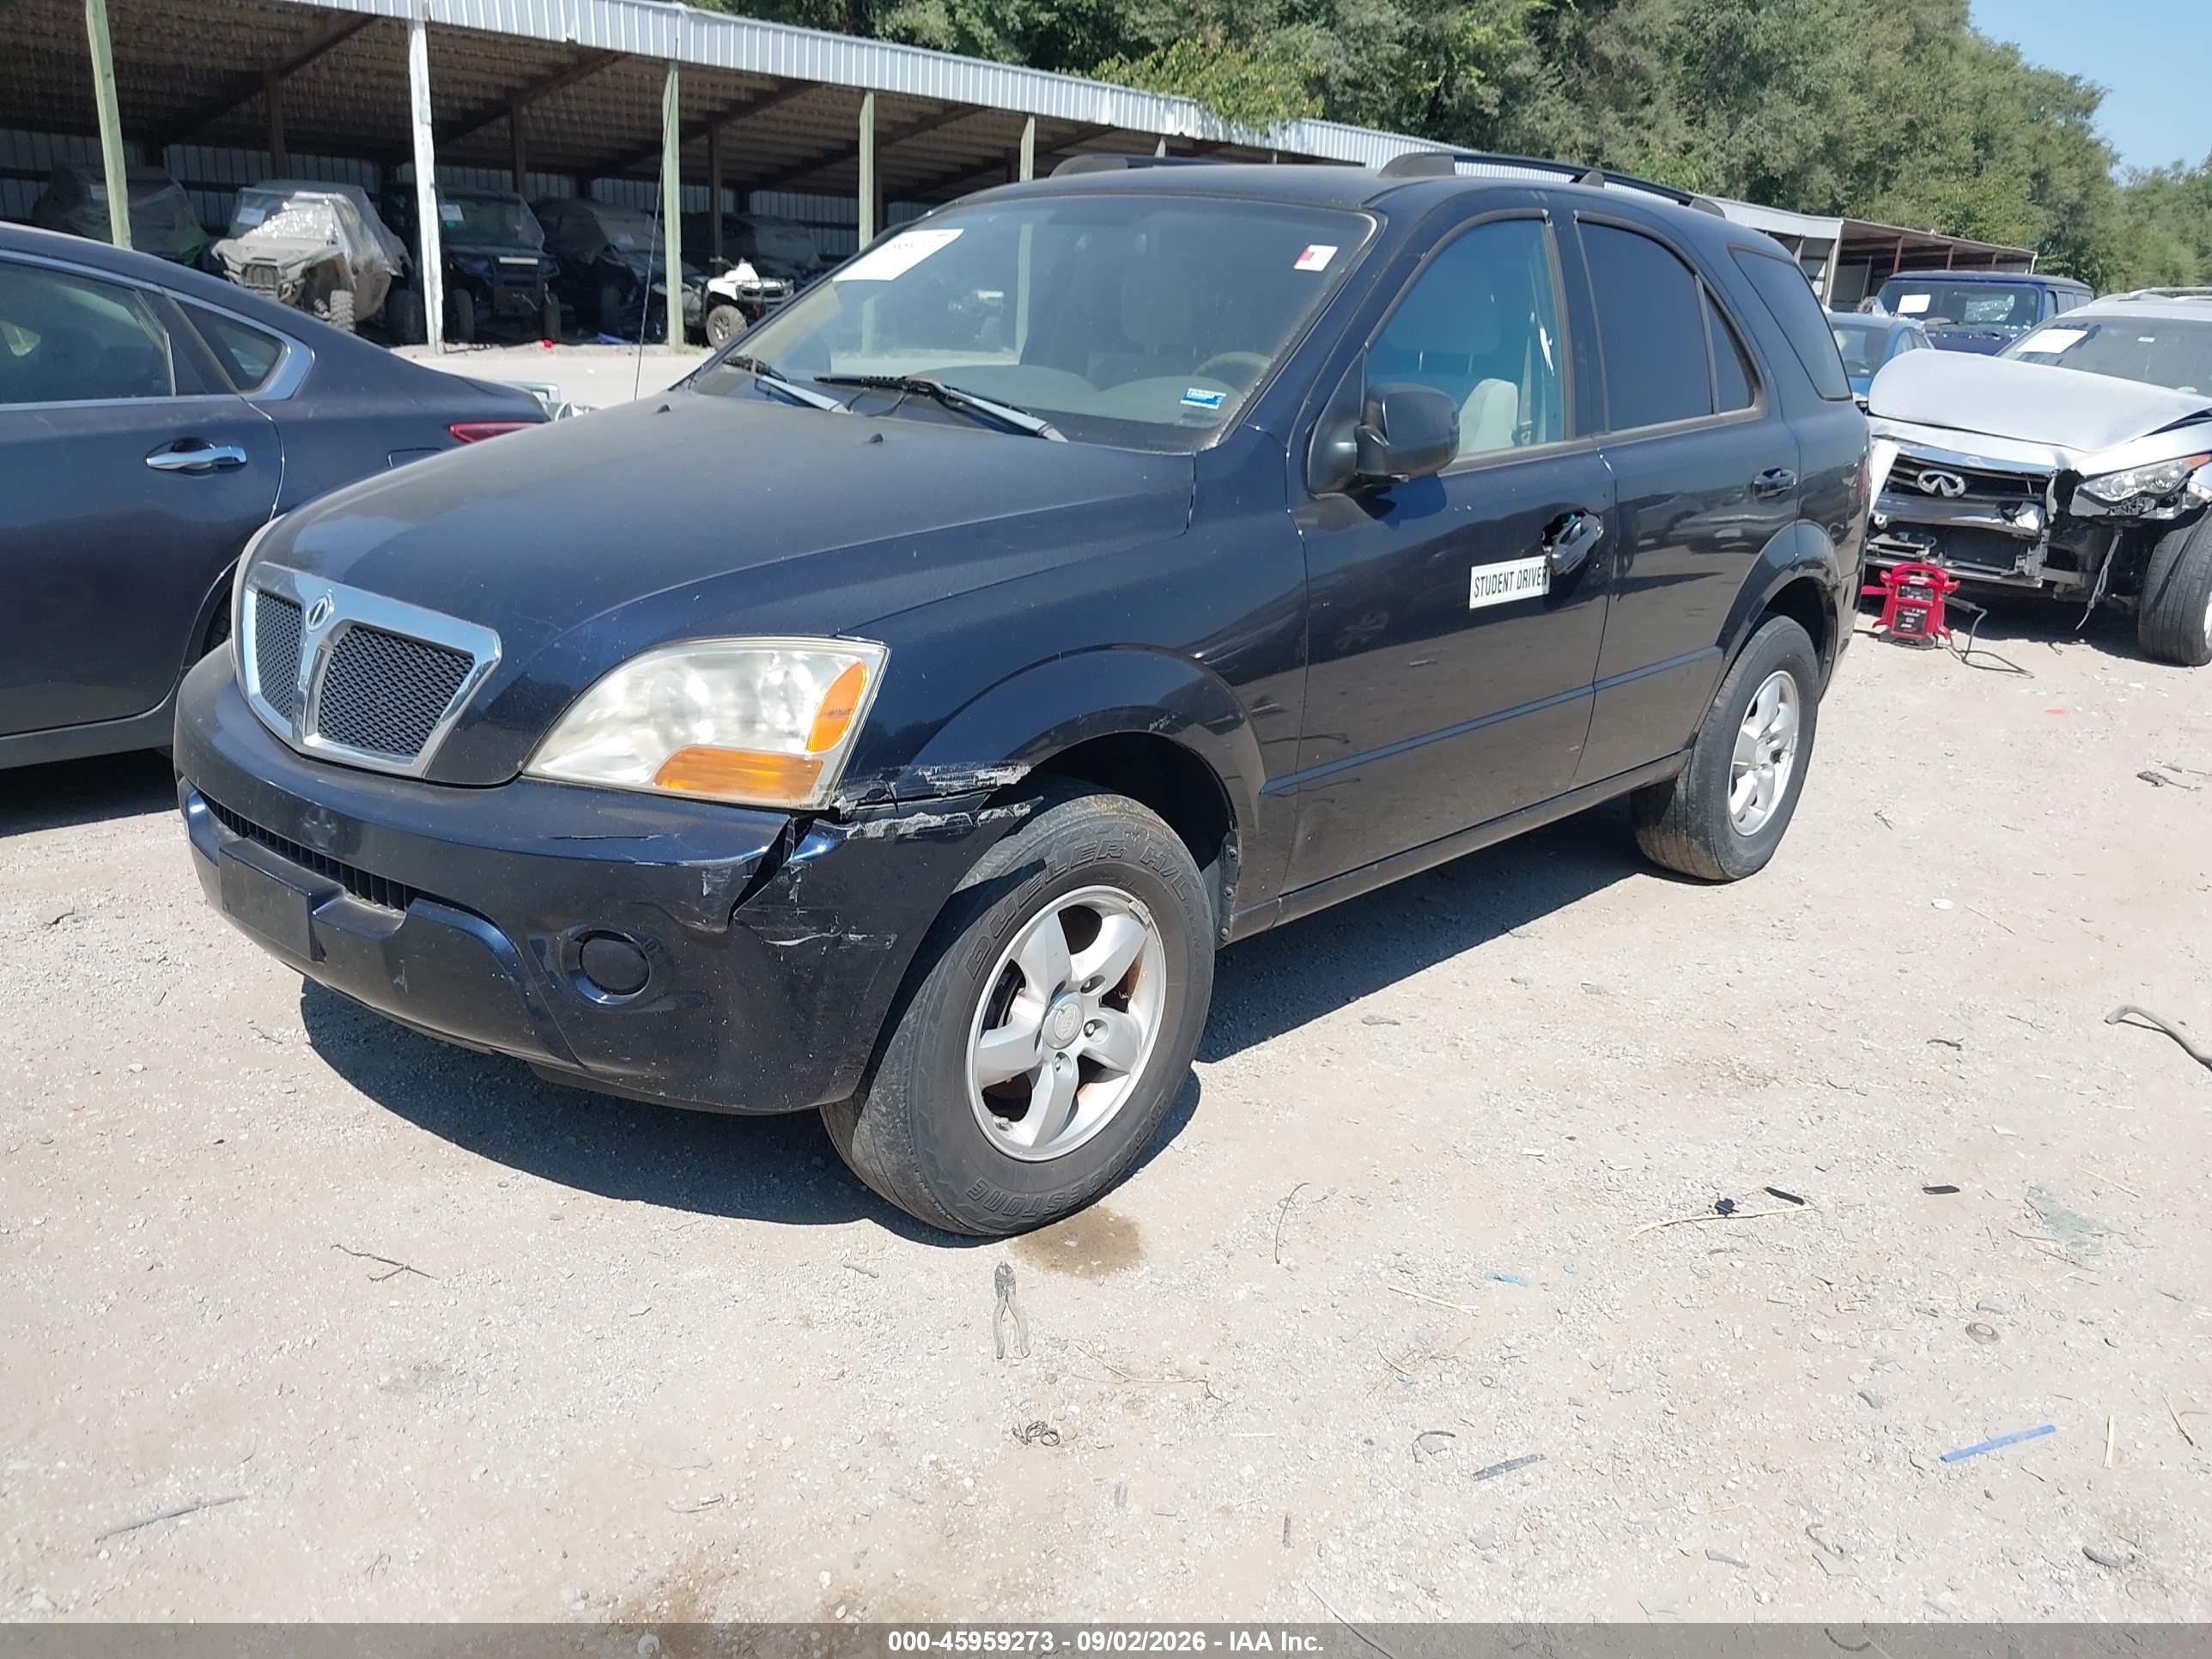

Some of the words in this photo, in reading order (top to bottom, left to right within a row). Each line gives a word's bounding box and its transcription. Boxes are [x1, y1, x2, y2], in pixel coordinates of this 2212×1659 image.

[1474, 571, 1515, 599] STUDENT
[1516, 566, 1547, 590] DRIVER
[966, 839, 1127, 979] DUELER
[1139, 846, 1186, 901] H/L
